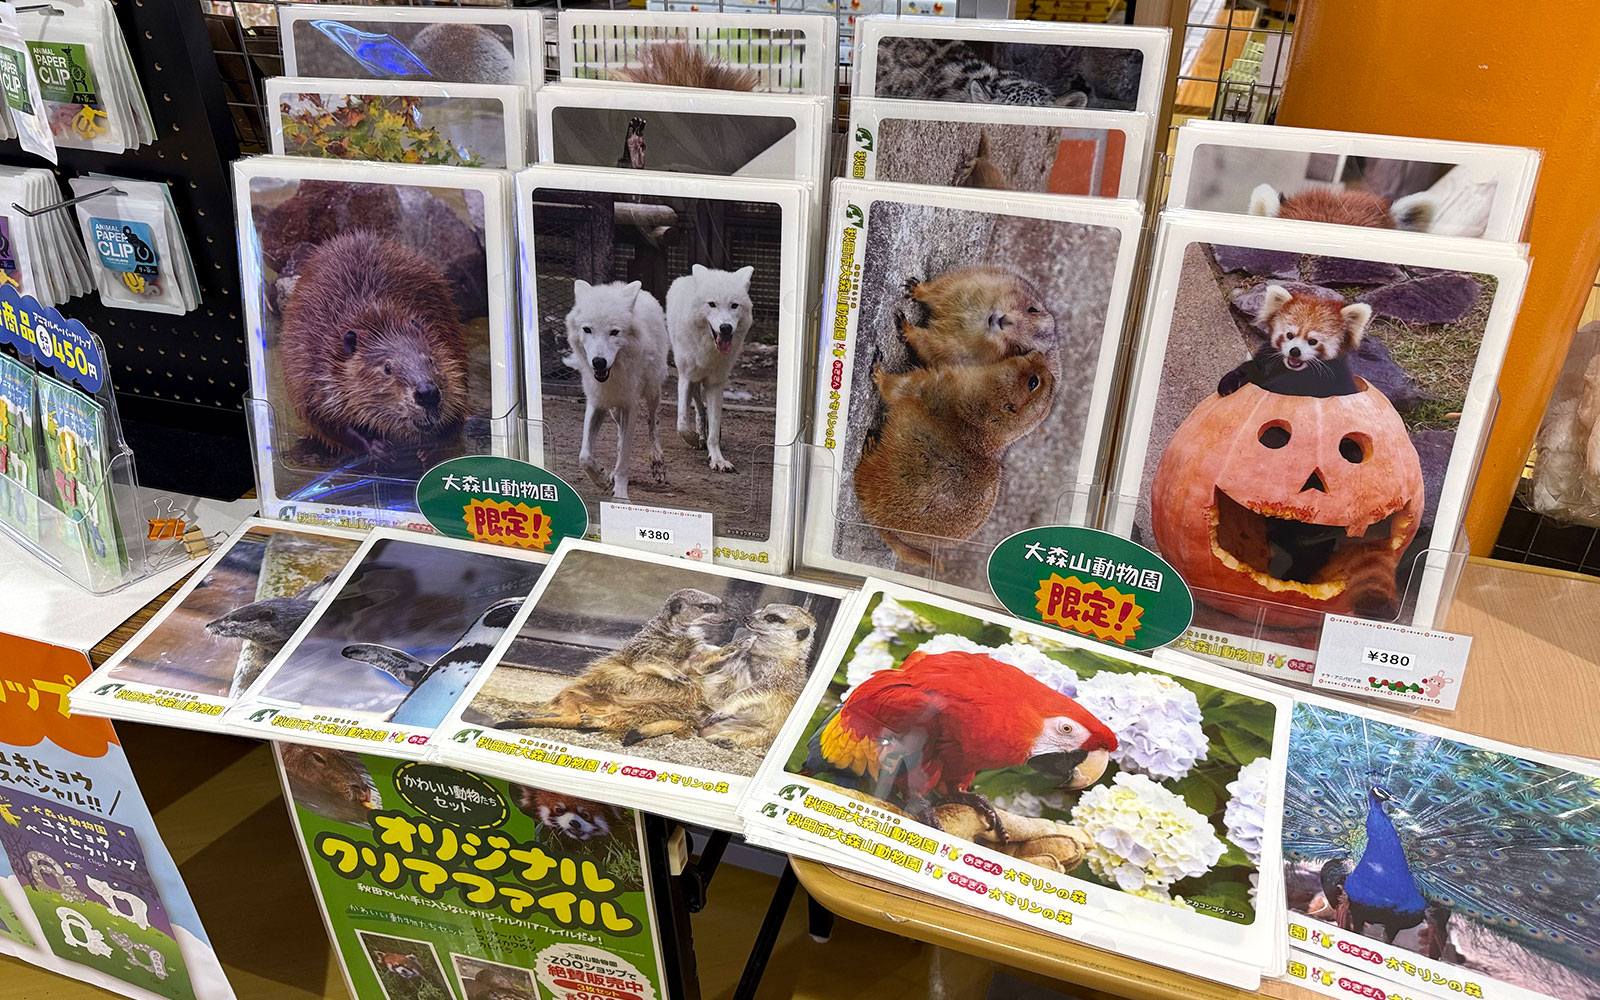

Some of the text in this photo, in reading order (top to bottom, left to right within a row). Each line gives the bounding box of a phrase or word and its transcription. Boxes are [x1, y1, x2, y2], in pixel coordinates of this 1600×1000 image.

[33, 47, 55, 55] ANIMAL
[35, 55, 67, 68] PAPER
[3, 73, 21, 94] CLIP
[39, 66, 71, 86] CLIP
[95, 224, 120, 232] ANIMAL
[96, 230, 129, 243] PAPER
[97, 240, 134, 258] CLIP
[833, 226, 857, 341] 秋田市大森山動物園
[0, 301, 37, 345] 商品
[53, 333, 98, 381] 450円
[824, 390, 840, 450] オモリンの森
[441, 474, 559, 502] 大森山動物園
[474, 505, 544, 540] 限定!
[639, 528, 670, 541] ¥380
[714, 547, 769, 563] オモリンの森
[1024, 541, 1163, 592] 大森山動物園
[1046, 582, 1133, 631] 限定!
[1367, 650, 1410, 668] ¥380
[114, 689, 225, 716] 秋田市大森山動物園
[271, 714, 389, 742] 秋田市大森山動物園
[476, 736, 730, 794] 秋田市大森山動物園 あきぎん オモリンの森
[403, 773, 497, 808] かわいい動物たち
[433, 795, 472, 813] セット
[31, 804, 108, 836] 大森山動物園
[41, 817, 109, 849] ユキヒョウ
[26, 824, 137, 871] ペーパークリップ
[375, 816, 615, 892] オリジナル
[802, 794, 1087, 905] 秋田市大森山動物園 あきぎん オモリンの森
[785, 811, 1073, 926] 秋田市大森山動物園 あきぎん オモリンの森
[322, 837, 634, 931] クリアファイル
[350, 903, 466, 936] かわいい動物たちセット
[549, 955, 637, 980] ZOOショップで
[565, 952, 618, 968] 大森山動物園
[1288, 923, 1483, 999] 園 あきぎん オモリンの森
[547, 964, 644, 993] 絶賛販売中
[577, 983, 621, 998] 3枚セット
